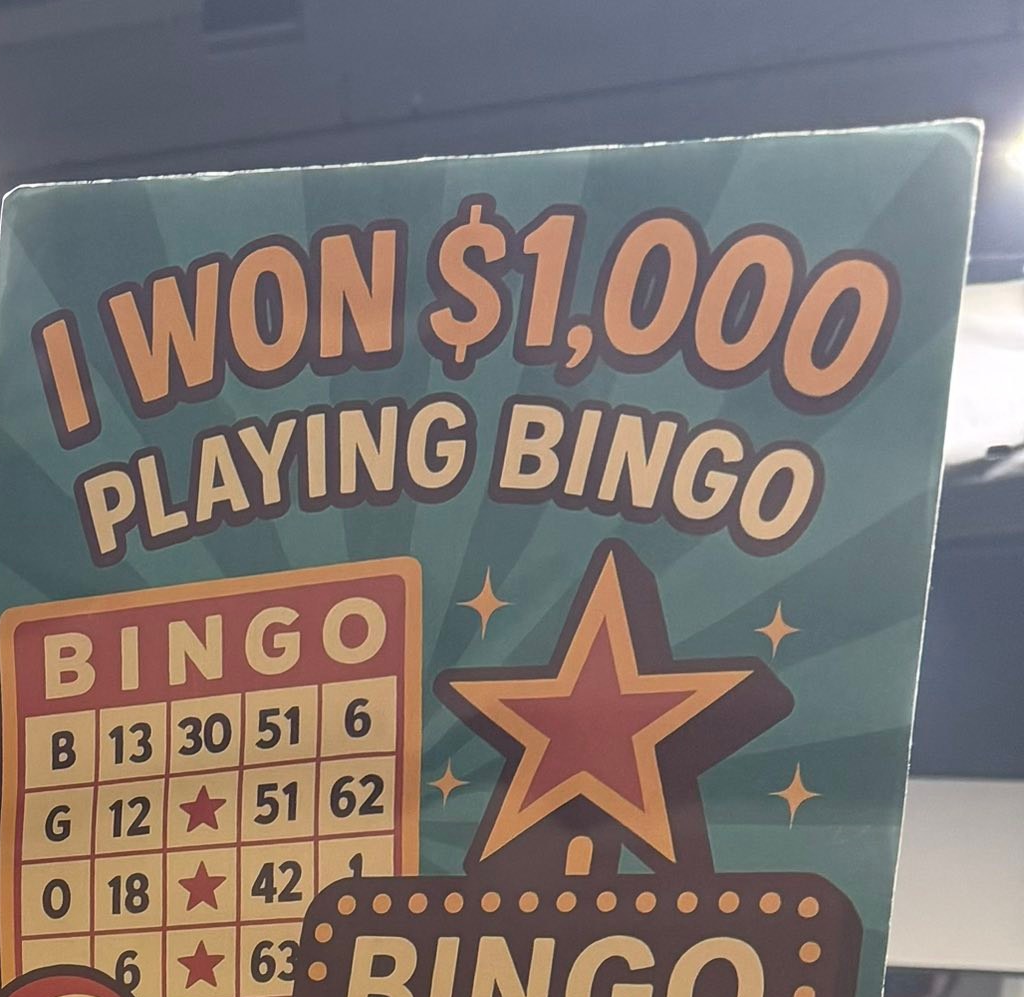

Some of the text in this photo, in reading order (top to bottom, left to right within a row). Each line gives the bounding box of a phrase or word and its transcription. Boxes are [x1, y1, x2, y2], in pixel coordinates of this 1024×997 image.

[42, 204, 889, 433] I WON $1,000
[84, 402, 815, 554] PLAYING BINGO
[44, 597, 387, 700] BINGO
[51, 698, 372, 771] B 13 30 51 6
[45, 774, 385, 842] G 12 51 62
[107, 873, 150, 915] 18
[251, 861, 303, 904] 42
[115, 941, 300, 991] 6 63
